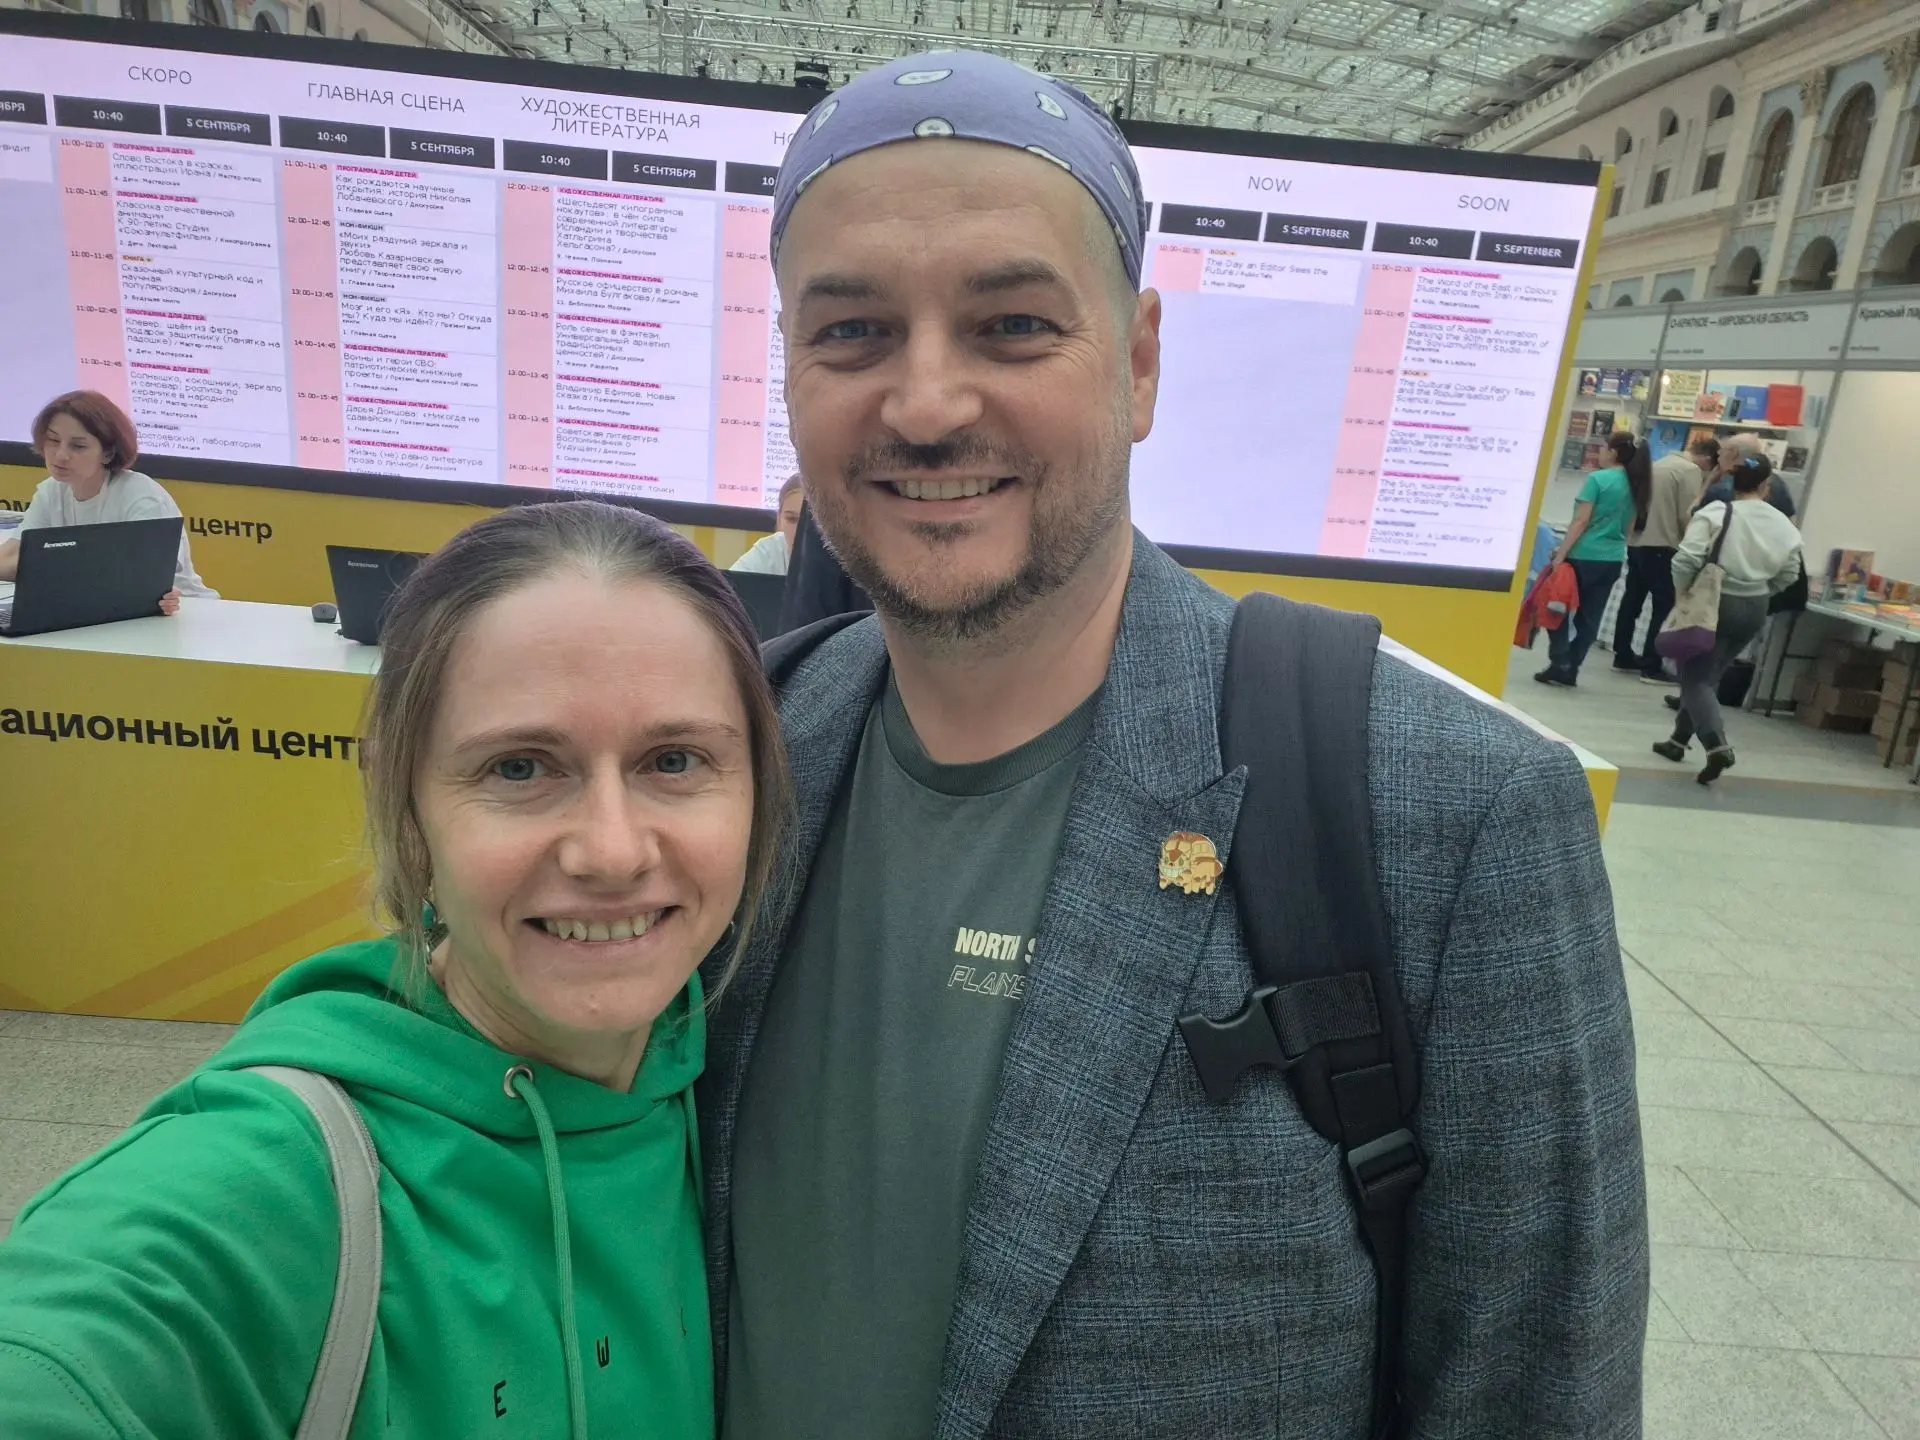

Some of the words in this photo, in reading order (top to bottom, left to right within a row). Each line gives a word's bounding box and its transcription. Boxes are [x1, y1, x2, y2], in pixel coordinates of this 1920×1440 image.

[128, 66, 192, 84] СКОРО
[308, 83, 394, 105] ГЛАВНАЯ
[401, 92, 465, 112] СЦЕНА
[92, 110, 123, 121] 10:40
[521, 97, 700, 129] ХУДОЖЕСТВЕННАЯ
[186, 118, 193, 127] 5
[195, 119, 250, 133] СЕНТЯБРЯ
[551, 117, 669, 142] ЛИТЕРАТУРА
[317, 131, 348, 143] 10:40
[410, 141, 417, 150] 5
[420, 142, 475, 156] СЕНТЯБРЯ
[541, 155, 571, 166] 10:40
[633, 164, 640, 173] 5
[642, 164, 696, 178] СЕНТЯБРЯ
[1248, 176, 1292, 193] NOW
[1457, 195, 1510, 212] SOON
[1196, 217, 1225, 228] 10:40
[1282, 225, 1289, 234] 5
[1291, 225, 1350, 239] SEPTEMBER
[1408, 236, 1438, 247] 10:40
[1494, 243, 1501, 253] 5
[1503, 244, 1562, 258] SEPTEMBER
[189, 517, 273, 544] центр
[252, 727, 362, 769] цент
[955, 927, 1021, 960] NORTH
